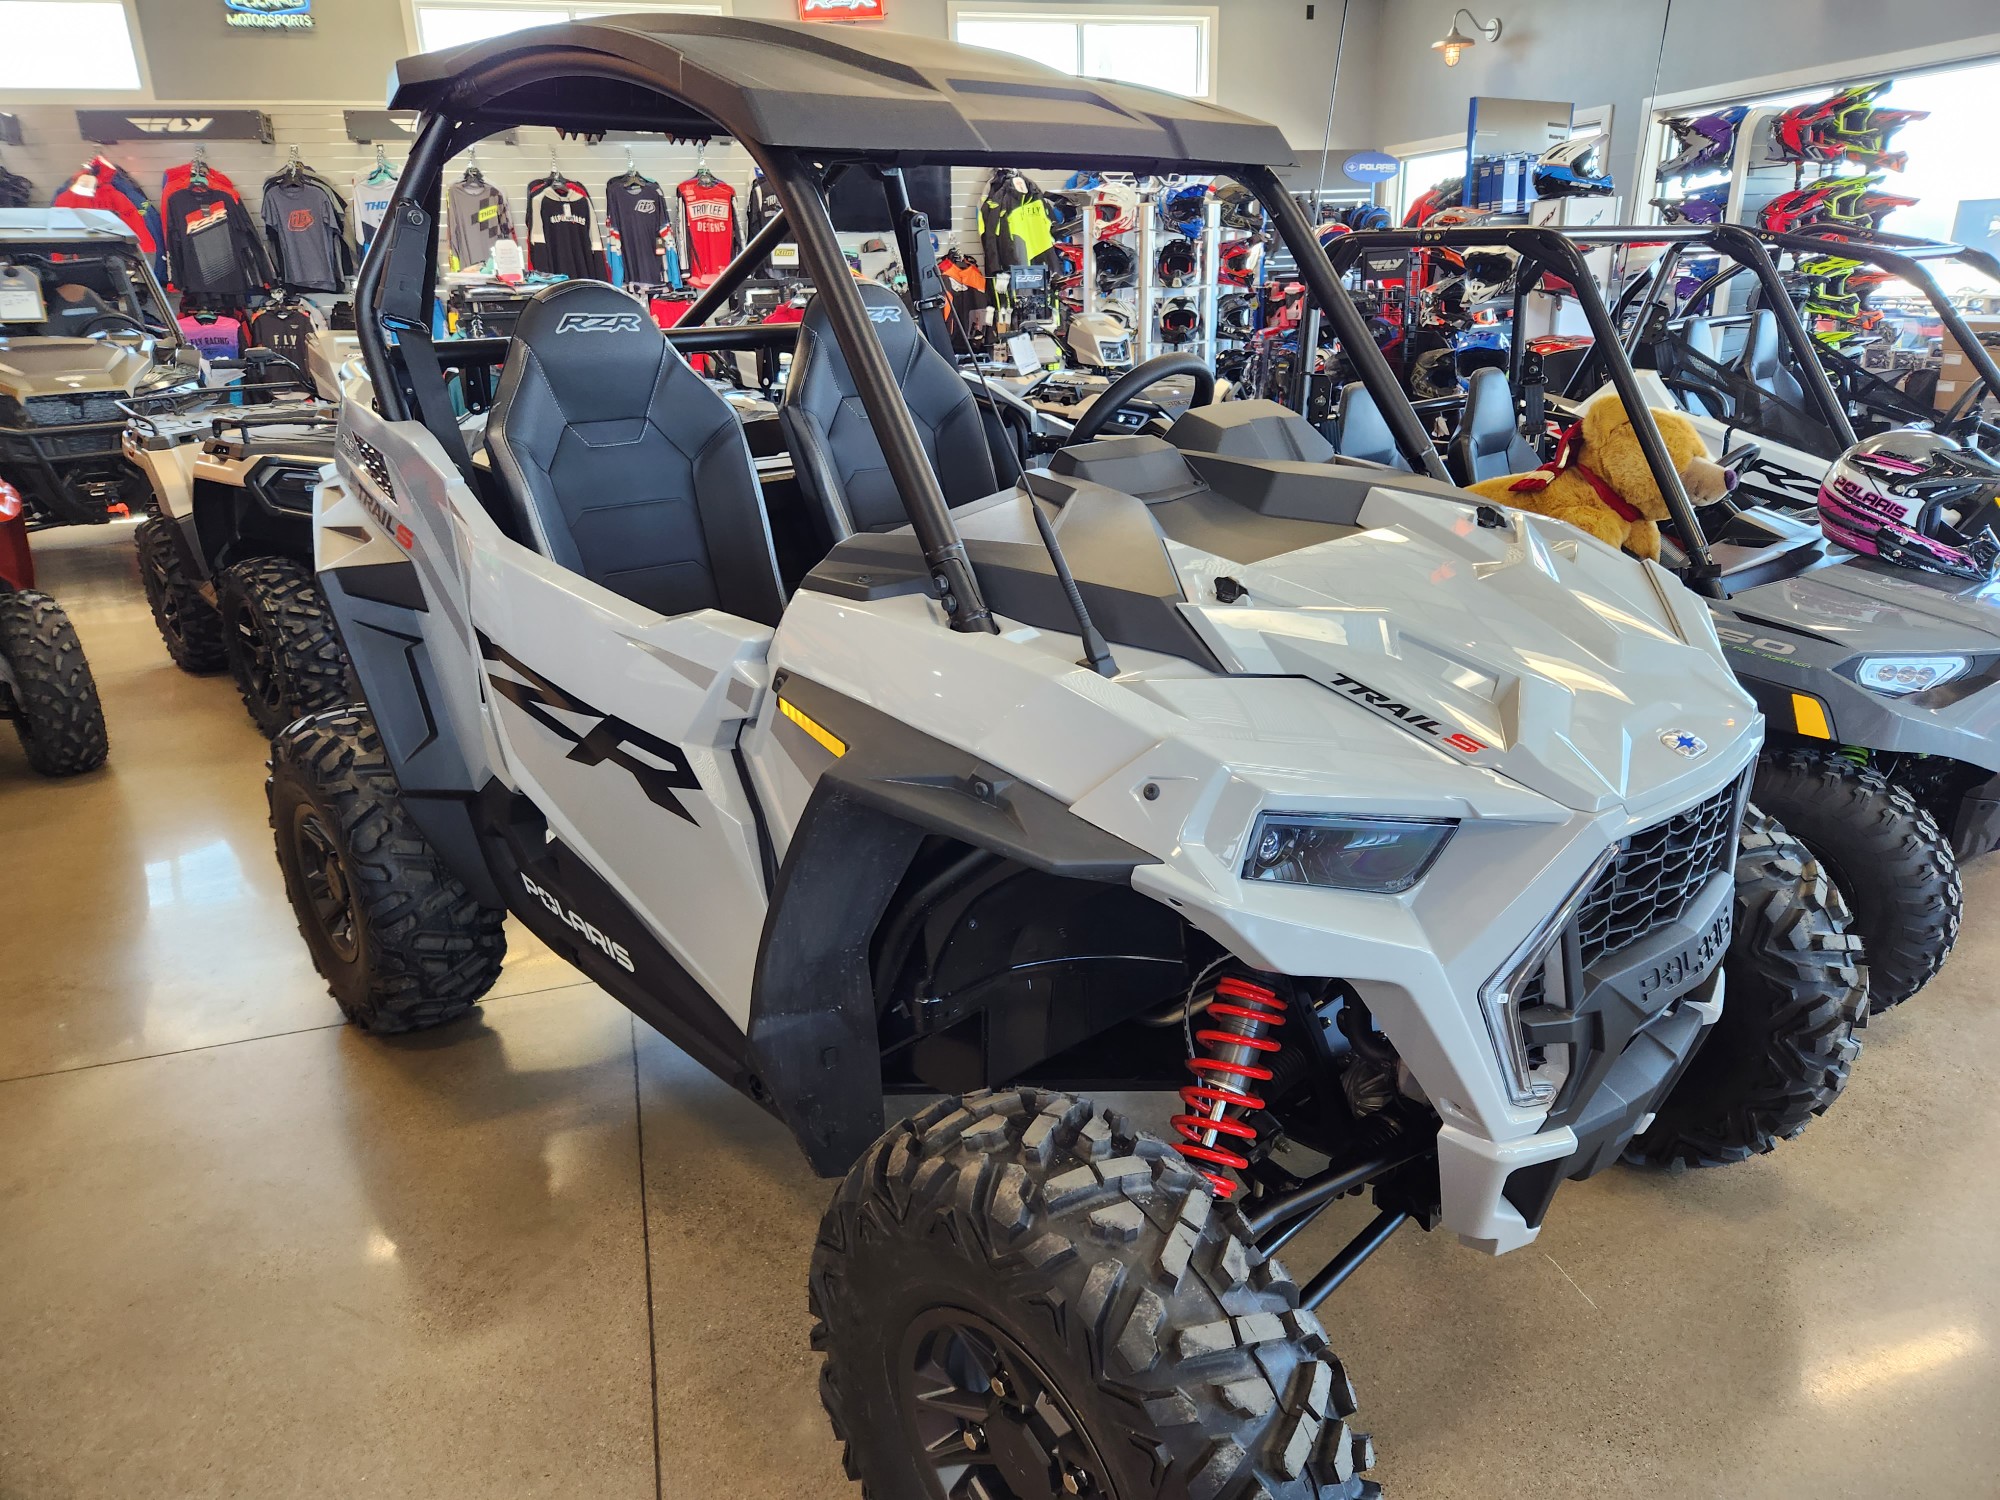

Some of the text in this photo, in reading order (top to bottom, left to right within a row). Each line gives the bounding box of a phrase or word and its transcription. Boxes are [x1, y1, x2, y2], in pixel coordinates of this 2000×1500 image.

[226, 13, 314, 28] MOTORSPORTS
[126, 117, 213, 132] FLY
[1359, 163, 1397, 171] POLARIS
[365, 201, 389, 210] THO
[710, 203, 722, 216] LEE
[1368, 258, 1405, 270] FLY
[556, 312, 642, 334] RZR
[204, 336, 230, 346] RACING
[274, 334, 298, 346] FLY
[1833, 475, 1909, 519] POLARIS
[358, 483, 415, 550] TRAIL S
[1732, 645, 1757, 655] FUEL
[1761, 653, 1812, 669] INJECTION
[1330, 672, 1489, 753] TRAIL S
[520, 871, 635, 973] POLARIS
[1640, 904, 1730, 1004] POLARIS
